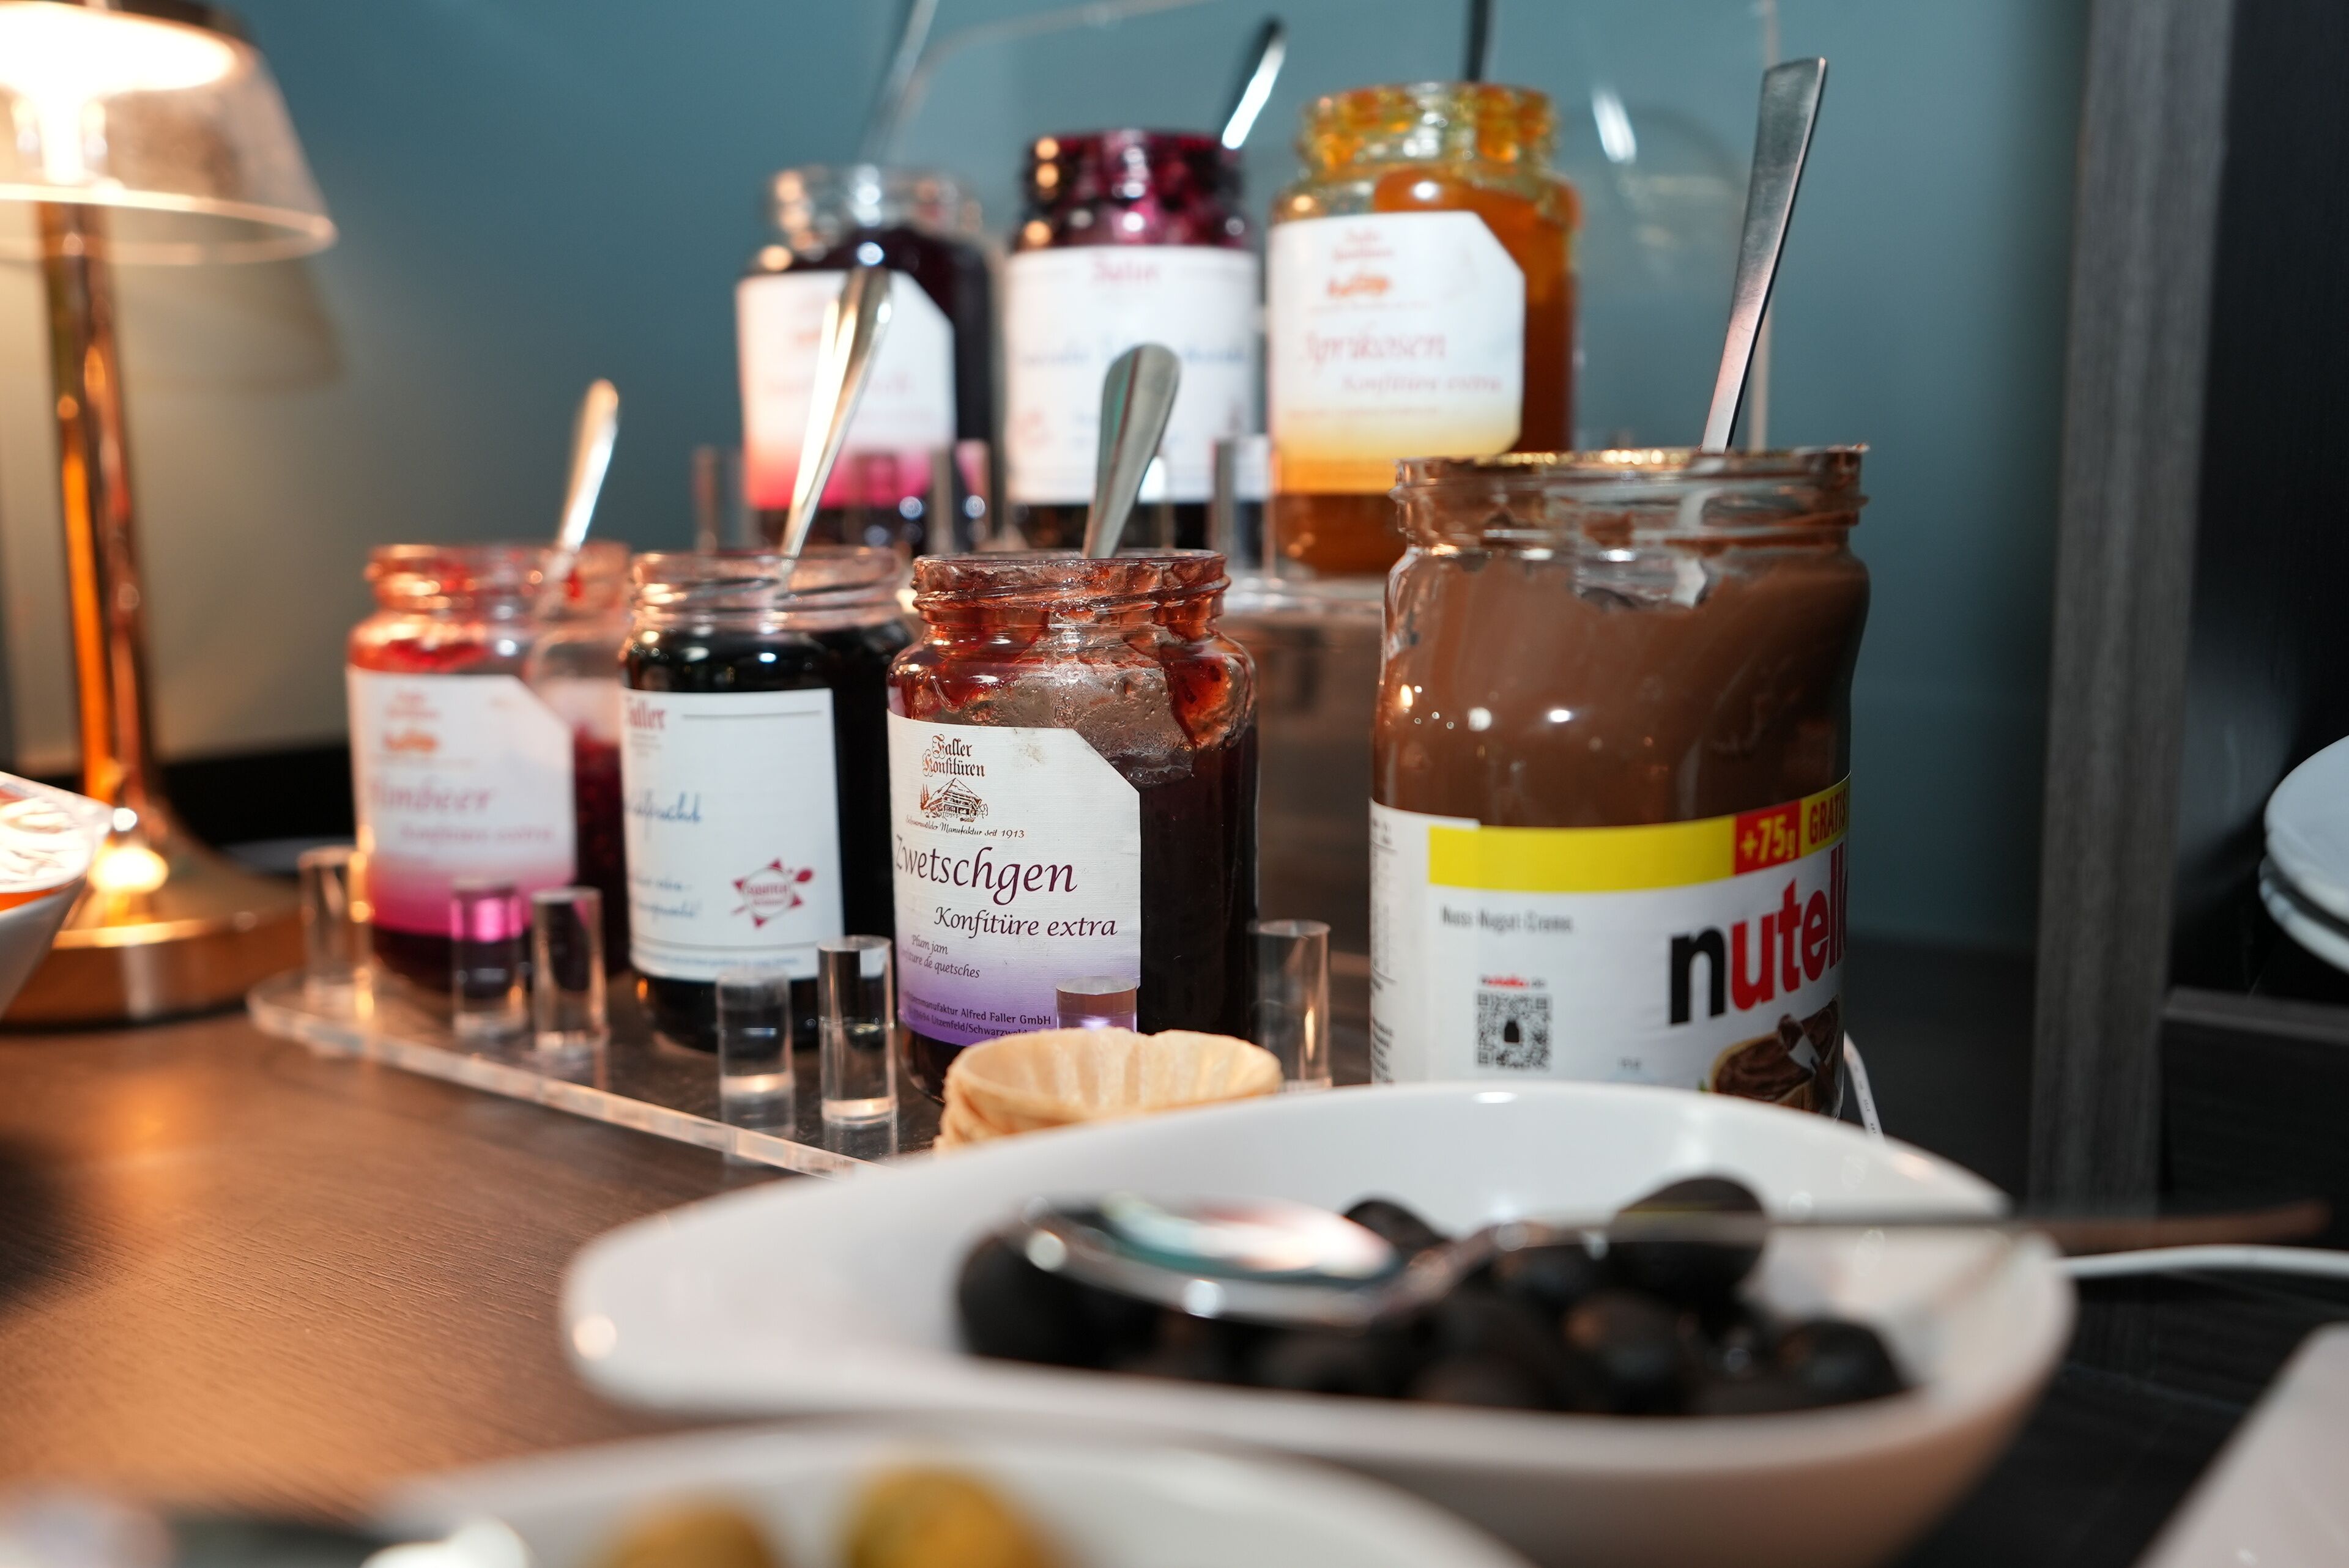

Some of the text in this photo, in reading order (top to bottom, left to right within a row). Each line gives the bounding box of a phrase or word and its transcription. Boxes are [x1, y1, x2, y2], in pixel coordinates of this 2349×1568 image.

[932, 734, 972, 759] Faller
[922, 749, 985, 777] Konfitüren
[940, 822, 982, 836] Manufaktur
[1001, 829, 1025, 839] 1913
[1739, 787, 1846, 864] +75g GRATIS
[896, 834, 1077, 905] Zwetschgen
[933, 906, 1118, 939] Konfitüre extra
[1669, 842, 1847, 1026] nutell
[929, 941, 948, 955] jam
[924, 955, 933, 969] de
[935, 961, 981, 978] quetsches
[960, 1008, 987, 1021] Alfred
[989, 1011, 1016, 1023] Faller
[1019, 1015, 1051, 1025] GmbH
